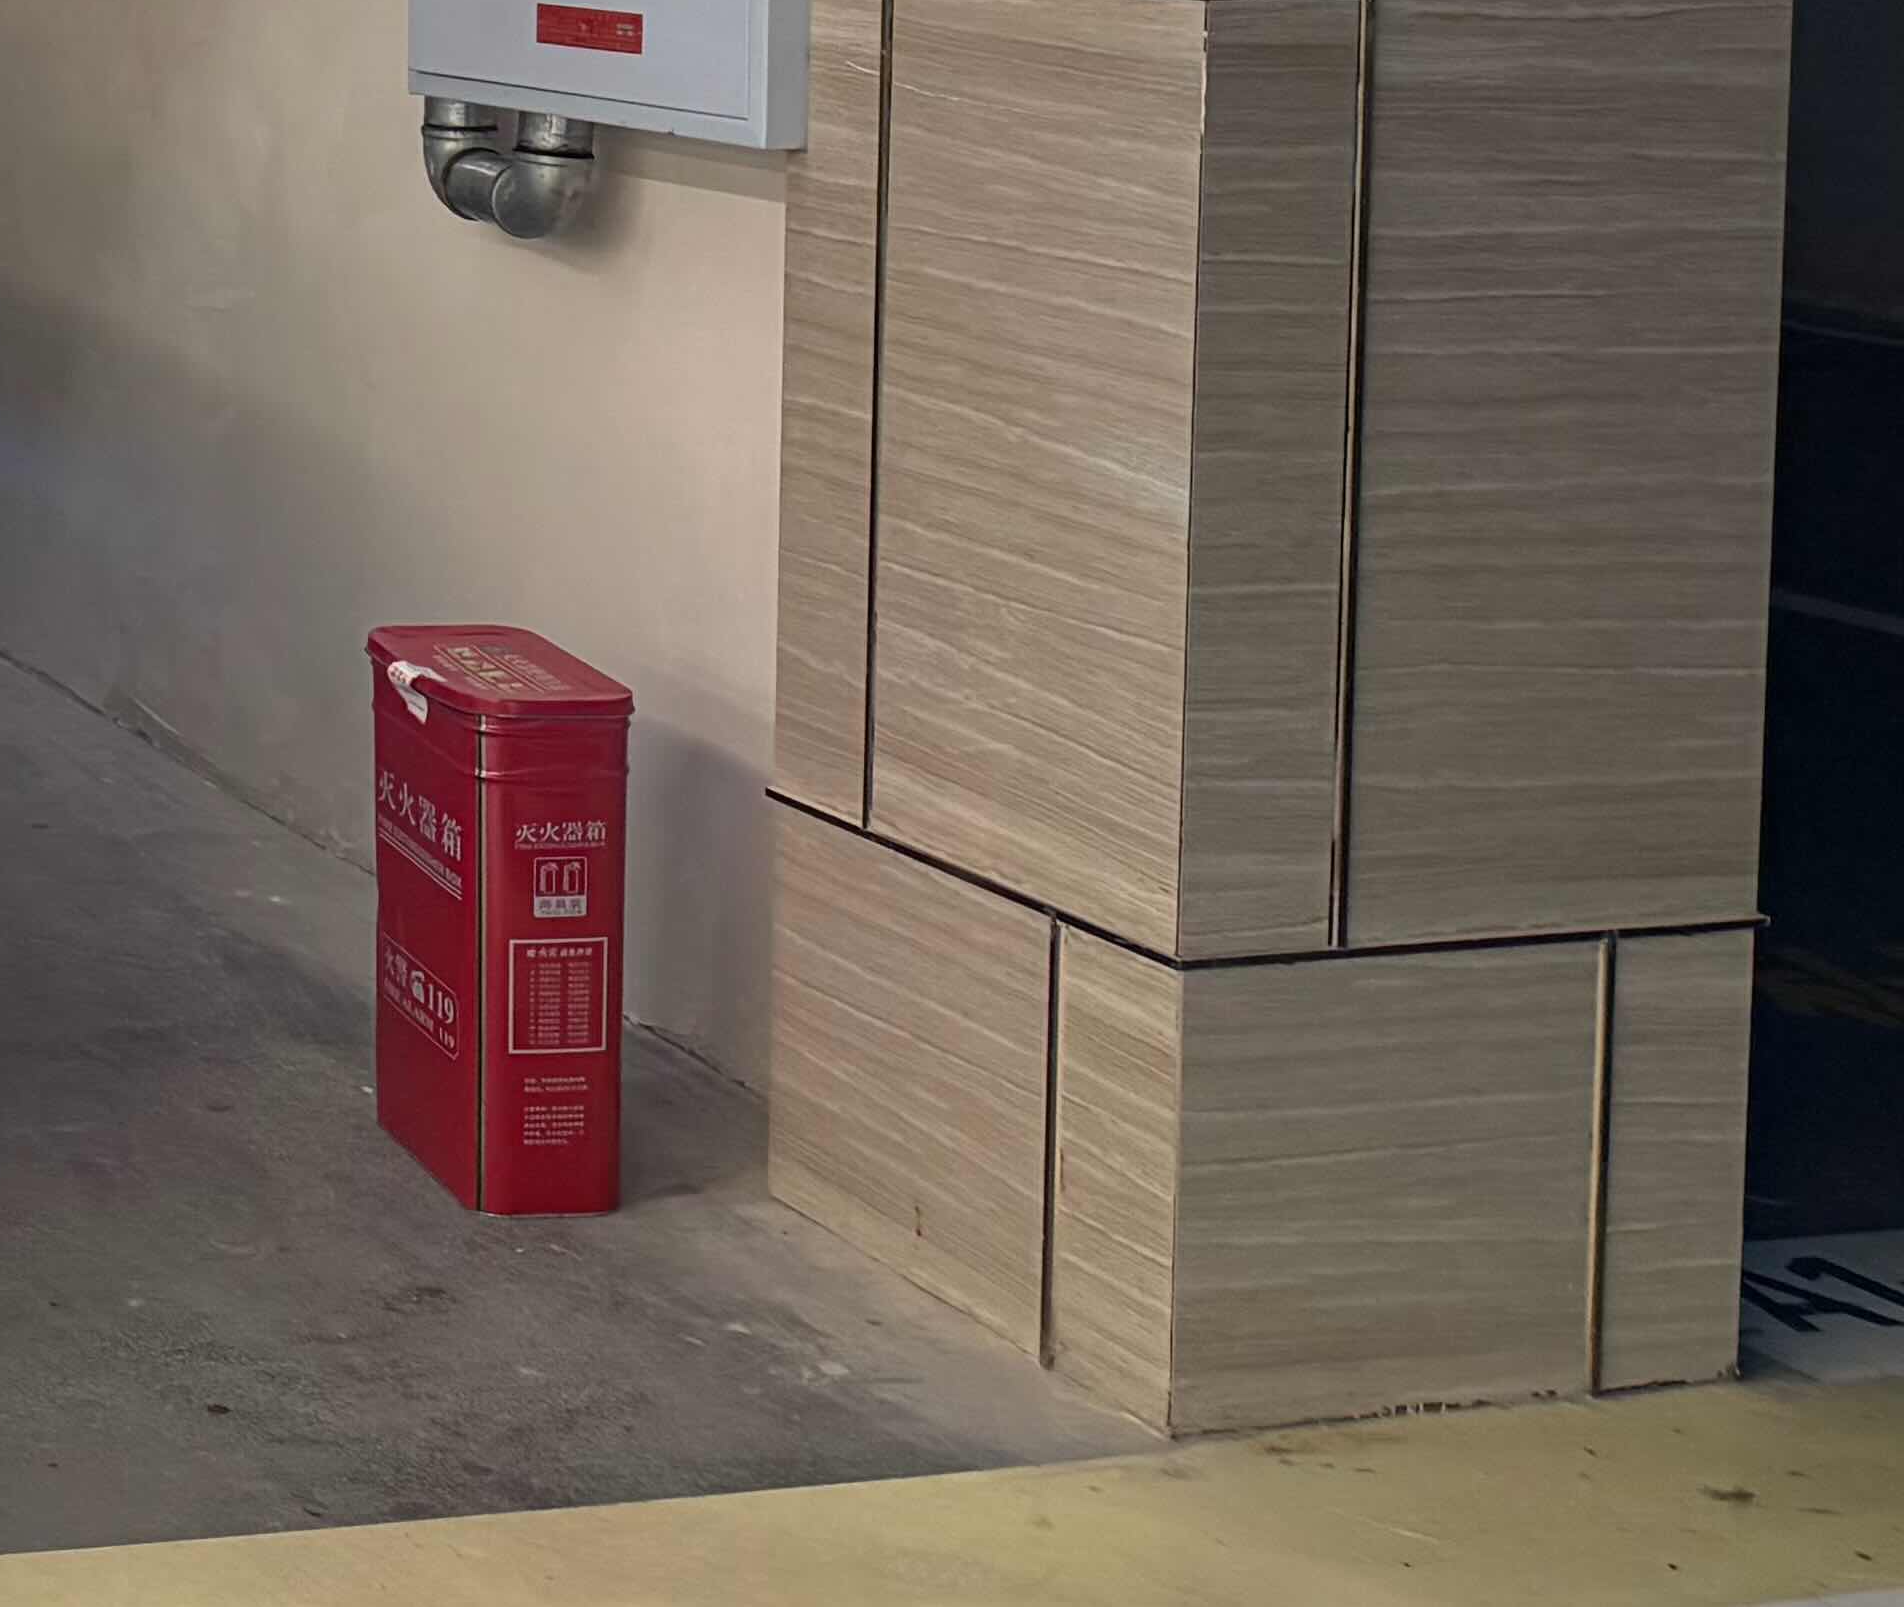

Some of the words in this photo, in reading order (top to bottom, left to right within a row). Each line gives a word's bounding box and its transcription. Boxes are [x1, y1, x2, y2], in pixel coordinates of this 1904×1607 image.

[378, 770, 463, 863] 灭火器箱
[514, 819, 607, 843] 灭火器箱
[428, 983, 455, 1025] 119
